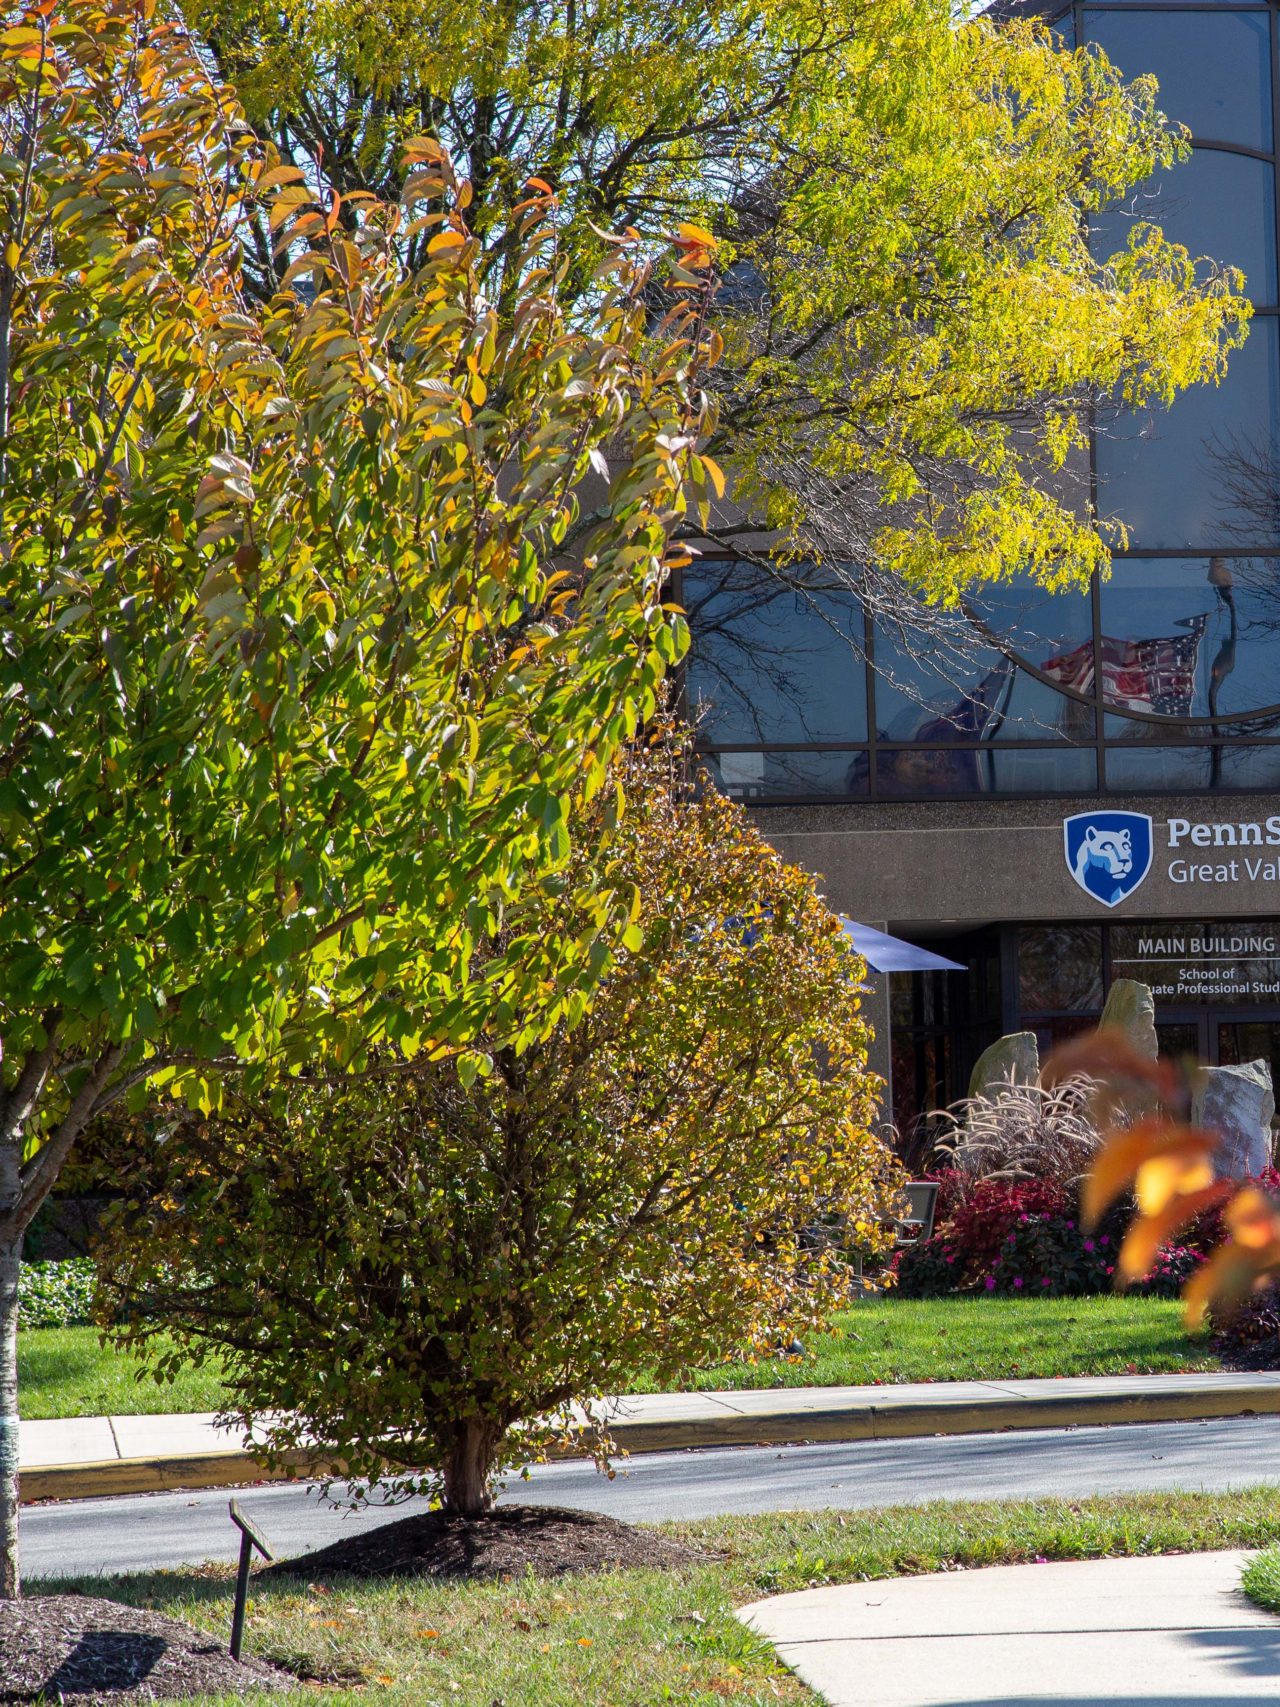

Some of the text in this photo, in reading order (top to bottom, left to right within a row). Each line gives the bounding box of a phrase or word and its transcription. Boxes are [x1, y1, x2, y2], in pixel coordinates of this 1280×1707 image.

[1168, 859, 1239, 883] Great
[1138, 937, 1275, 954] MAIN BUILDING
[1179, 967, 1235, 980] School of
[1177, 982, 1250, 994] Professional
